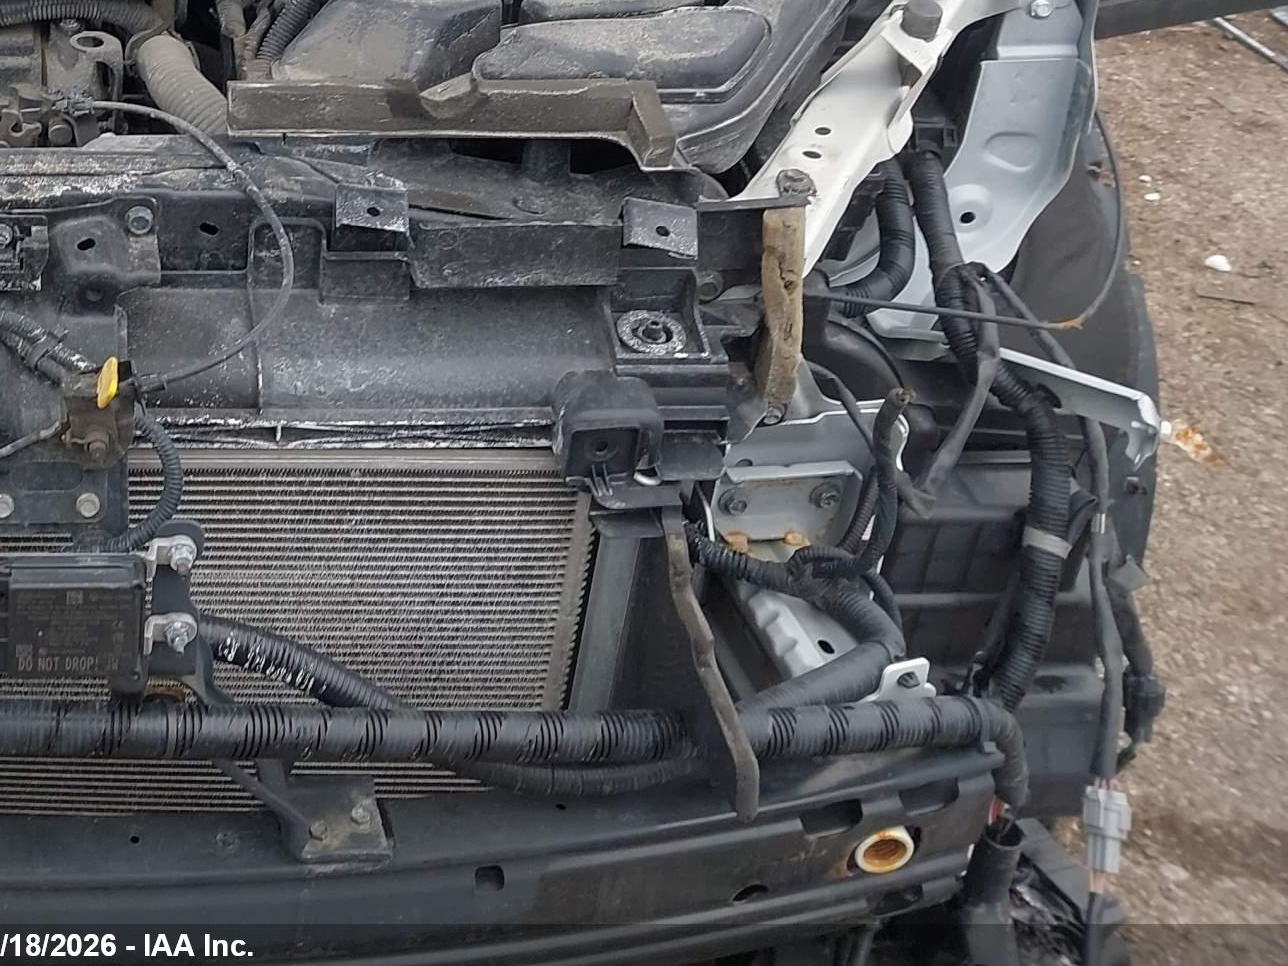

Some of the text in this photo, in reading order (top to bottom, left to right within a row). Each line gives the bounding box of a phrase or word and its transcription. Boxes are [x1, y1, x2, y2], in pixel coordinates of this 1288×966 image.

[18, 657, 33, 672] DO
[38, 656, 60, 671] NOT
[65, 656, 99, 671] DROP!
